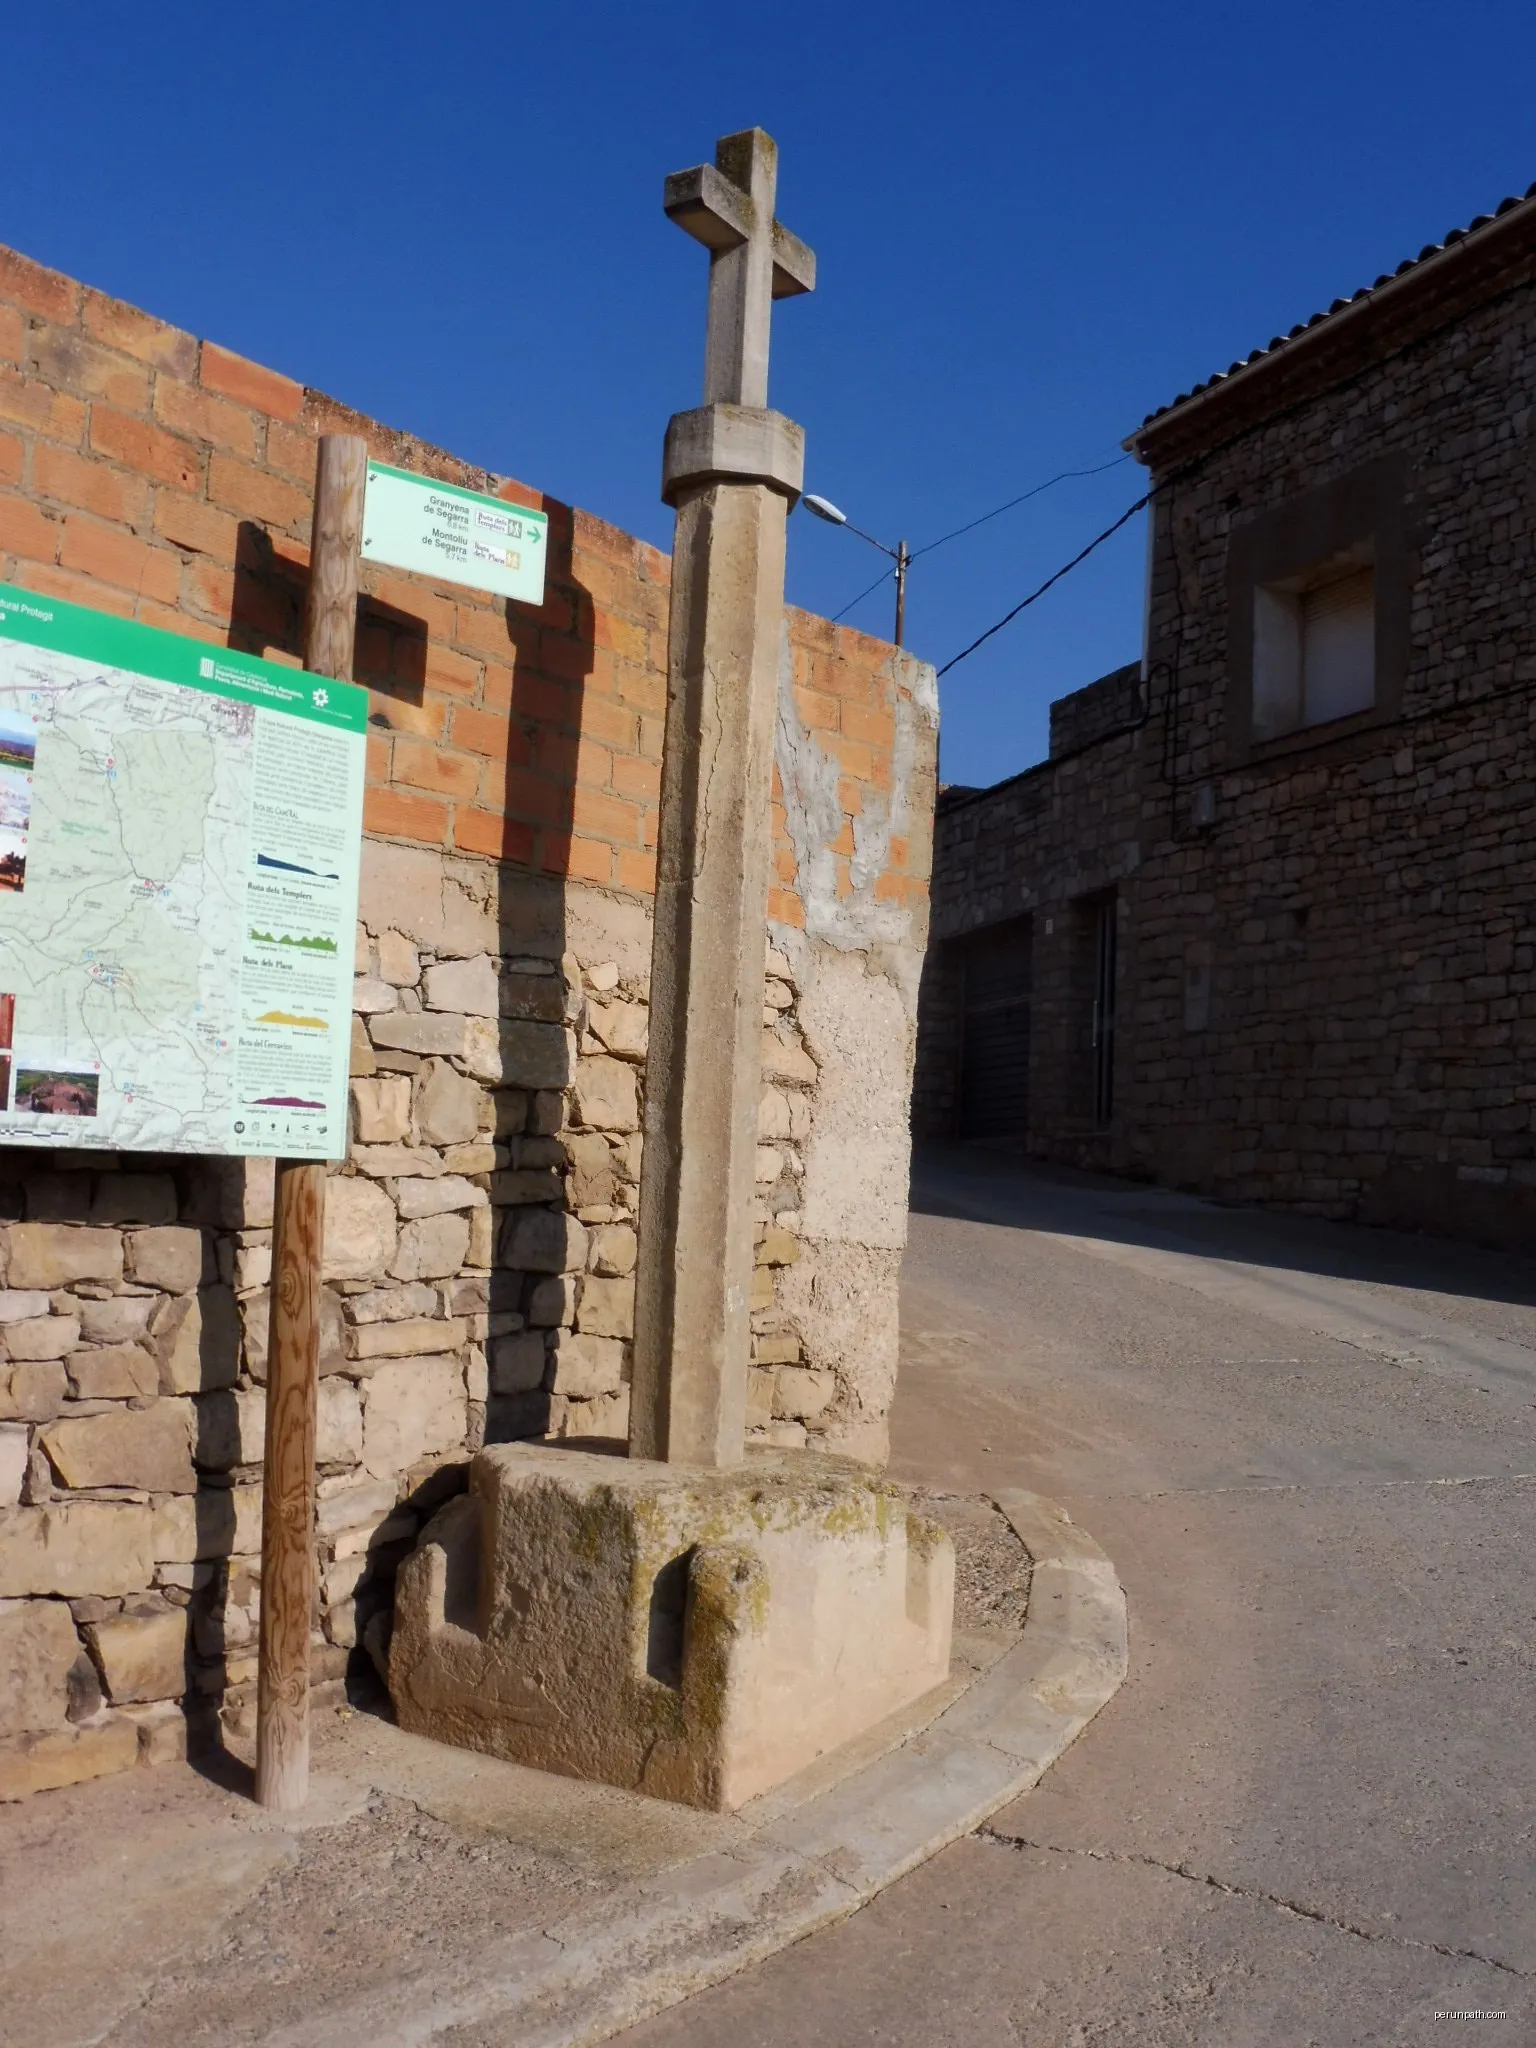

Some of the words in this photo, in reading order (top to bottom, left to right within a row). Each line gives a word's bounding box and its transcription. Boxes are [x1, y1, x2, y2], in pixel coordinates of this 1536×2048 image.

[423, 504, 435, 514] de
[436, 507, 469, 524] Segarra
[429, 495, 470, 514] Granyena
[421, 535, 433, 545] de
[434, 538, 467, 555] Segarra
[247, 881, 265, 891] Ruta
[265, 885, 280, 895] dels
[281, 887, 313, 900] Templers
